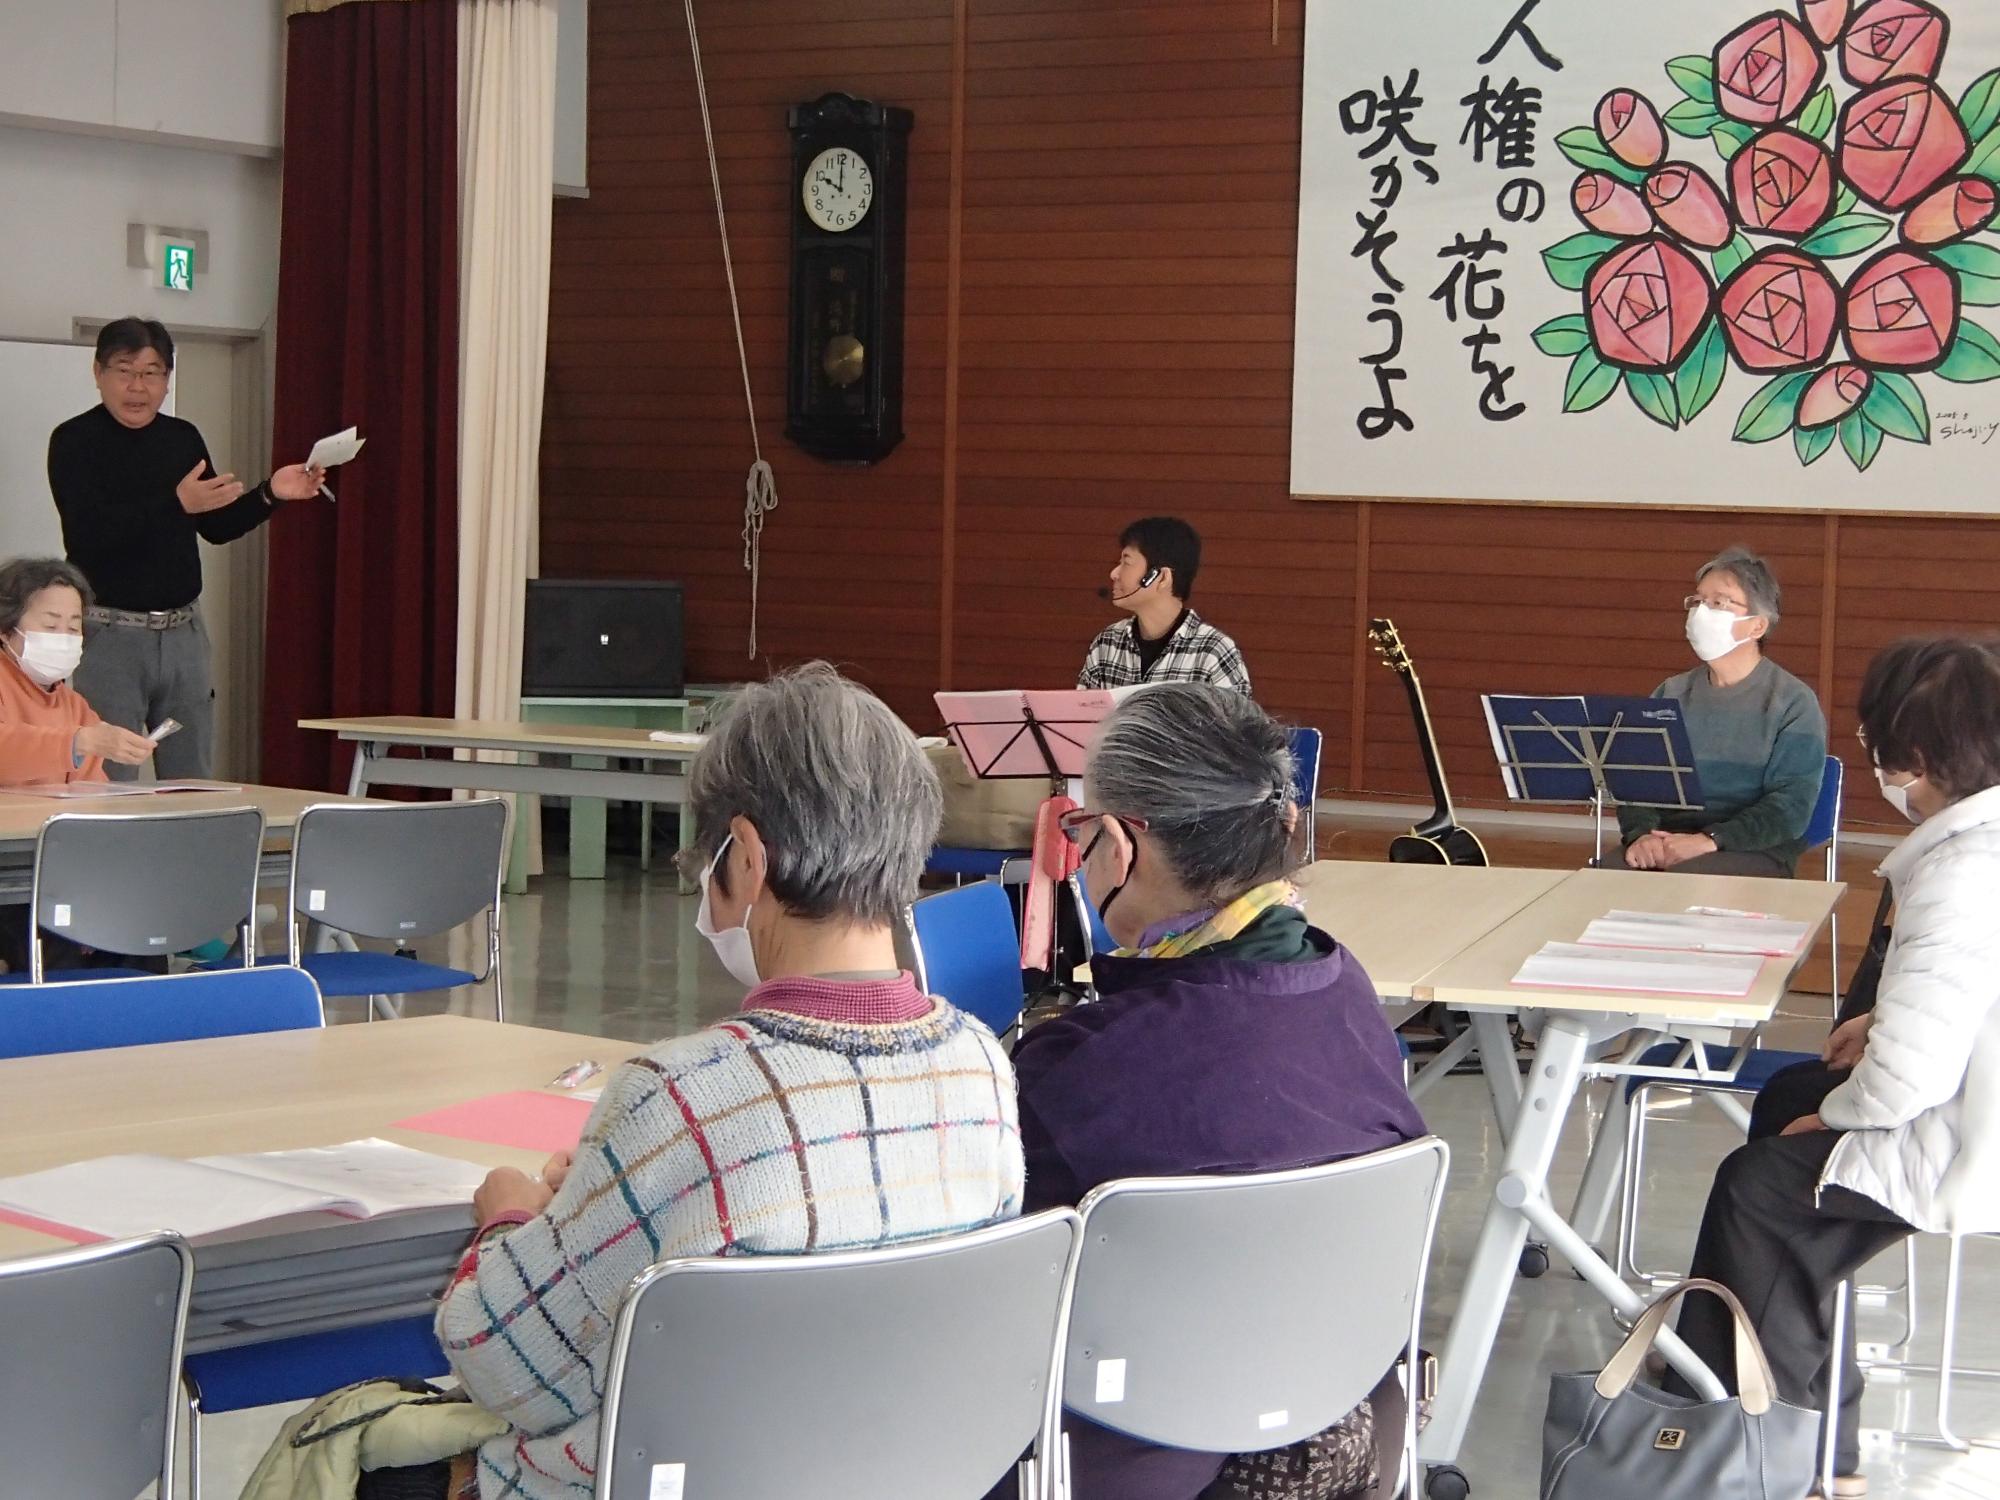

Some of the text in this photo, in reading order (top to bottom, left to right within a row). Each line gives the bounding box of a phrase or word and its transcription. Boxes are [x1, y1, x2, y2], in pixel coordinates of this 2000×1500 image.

[826, 158, 834, 169] 11
[837, 153, 847, 165] 12
[851, 158, 855, 169] 1
[816, 170, 826, 182] 10
[859, 168, 867, 179] 2
[811, 185, 819, 196] 9
[863, 184, 871, 195] 3
[815, 199, 824, 210] 8
[858, 198, 866, 209] 4
[826, 210, 833, 222] 7
[836, 214, 844, 225] 6
[848, 210, 857, 221] 5
[1338, 68, 1440, 440] 咲かそうよ
